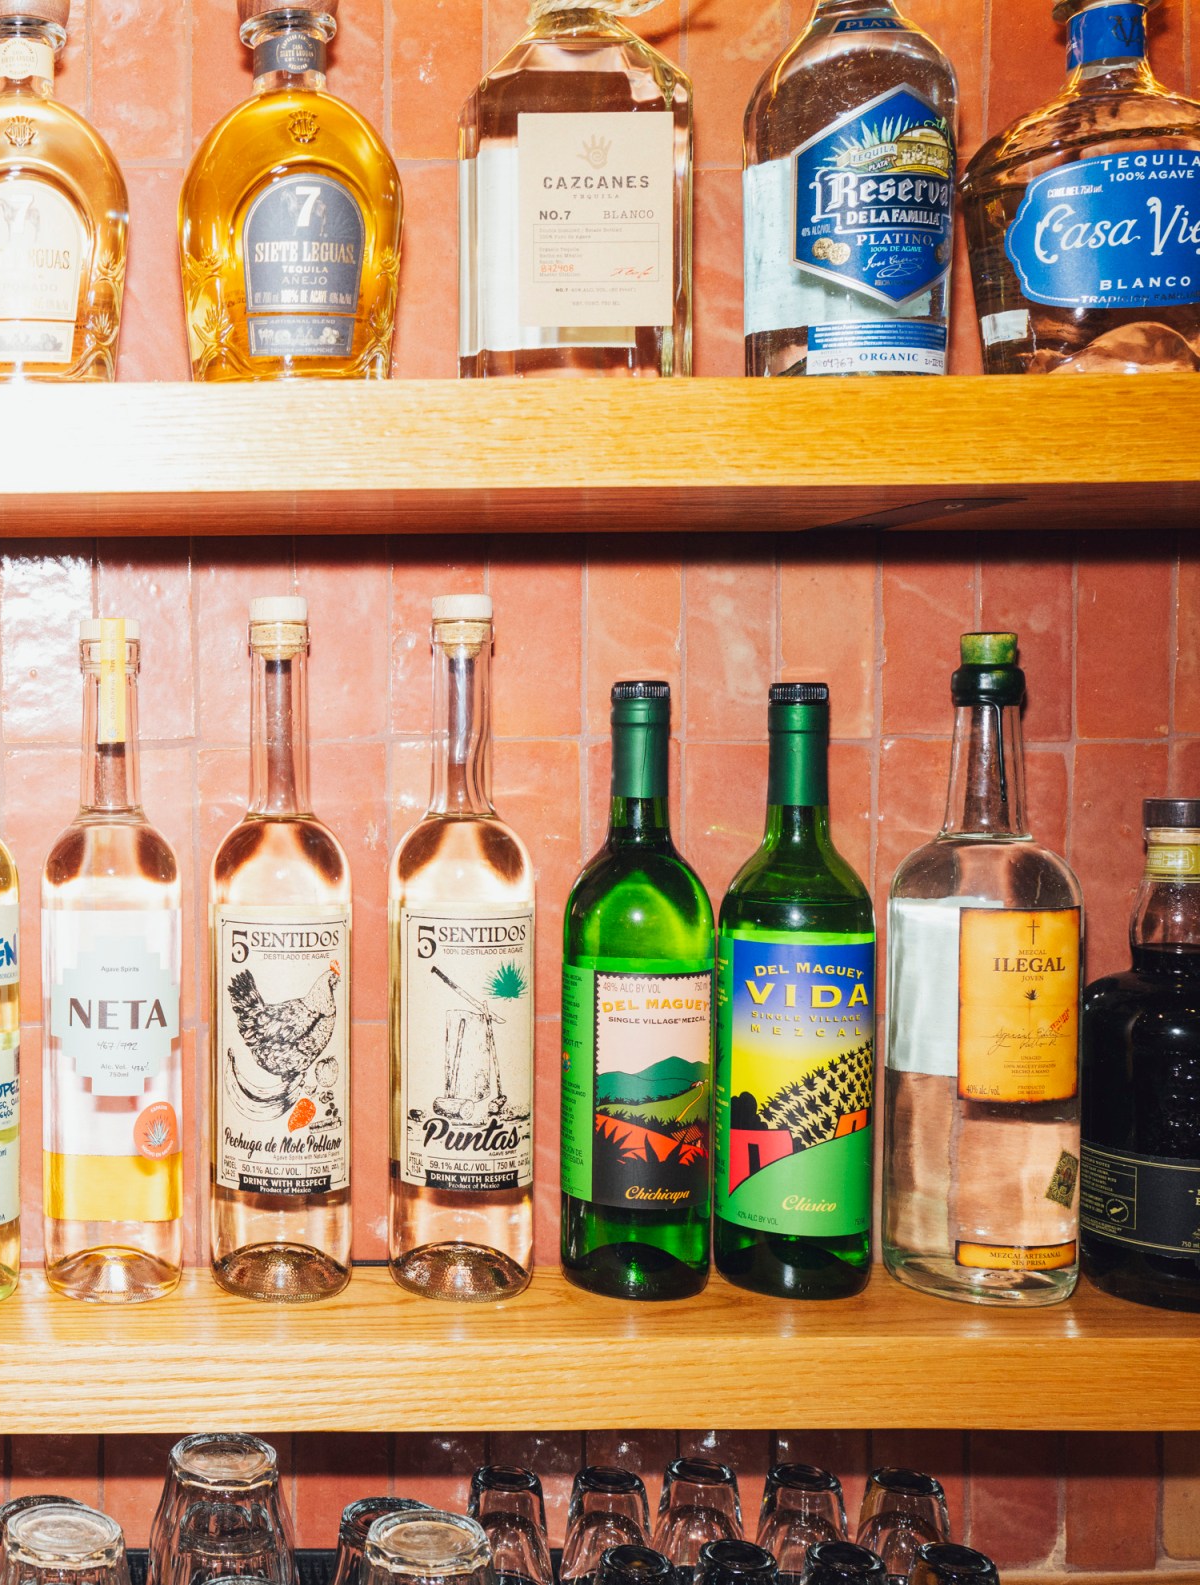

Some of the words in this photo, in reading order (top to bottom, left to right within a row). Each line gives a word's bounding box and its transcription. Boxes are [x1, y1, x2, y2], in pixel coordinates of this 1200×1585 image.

[852, 145, 896, 163] TEQUILA
[868, 161, 889, 172] PLATA
[543, 175, 649, 189] CAZCANES
[1109, 171, 1145, 182] 100%
[1148, 170, 1194, 180] AGAVE
[824, 172, 949, 213] Reserva
[295, 186, 321, 228] 7
[539, 210, 571, 220] NO.7
[603, 209, 654, 219] BLANCO
[846, 211, 867, 225] DE
[870, 209, 889, 223] LA
[891, 209, 941, 226] FAMILIA
[1034, 204, 1141, 264] Casa
[255, 241, 298, 263] SIETE
[302, 241, 356, 264] LEGUAS
[282, 266, 329, 274] TEQUILA
[281, 274, 328, 285] AÑEJO
[1100, 276, 1191, 290] BLANCO
[859, 352, 919, 362] ORGANIC
[232, 930, 249, 963] 5
[251, 930, 339, 948] SENTIDOS
[417, 925, 437, 959] 5
[439, 924, 526, 943] SENTIDOS
[754, 964, 789, 977] DEL
[796, 962, 864, 980] MAGUEY
[992, 957, 1066, 973] ILEGAL
[603, 982, 618, 992] 48%
[620, 982, 634, 993] ALC
[636, 983, 645, 993] BY
[647, 983, 661, 994] VOL
[745, 979, 869, 1009] VIDA
[602, 999, 639, 1013] DEL
[645, 998, 710, 1012] MAGUEY
[69, 998, 168, 1030] NETA
[608, 1016, 640, 1024] SINGLE
[681, 1015, 706, 1023] MEZCAL
[751, 1010, 801, 1022] SINGLE
[809, 1014, 861, 1023] VILLAGE
[750, 1023, 861, 1037] MEZCAL
[422, 1117, 521, 1152] Puntas
[224, 1126, 262, 1159] Pechuga
[265, 1136, 277, 1153] de
[280, 1135, 305, 1153] Mole
[307, 1134, 342, 1153] Poblano
[241, 1163, 263, 1173] 50.1%
[310, 1166, 321, 1174] 750
[429, 1160, 452, 1170] 59.1%
[497, 1161, 508, 1170] 750
[243, 1176, 269, 1186] DRINK
[271, 1178, 293, 1187] WITH
[295, 1177, 327, 1187] RESPECT
[430, 1173, 457, 1182] DRINK
[460, 1174, 482, 1183] WITH
[486, 1173, 515, 1182] RESPECT
[625, 1185, 690, 1204] Chichicapa
[782, 1194, 837, 1212] Clásico
[990, 1251, 1022, 1259] MEZCAL
[1024, 1251, 1062, 1259] ARTESANAL
